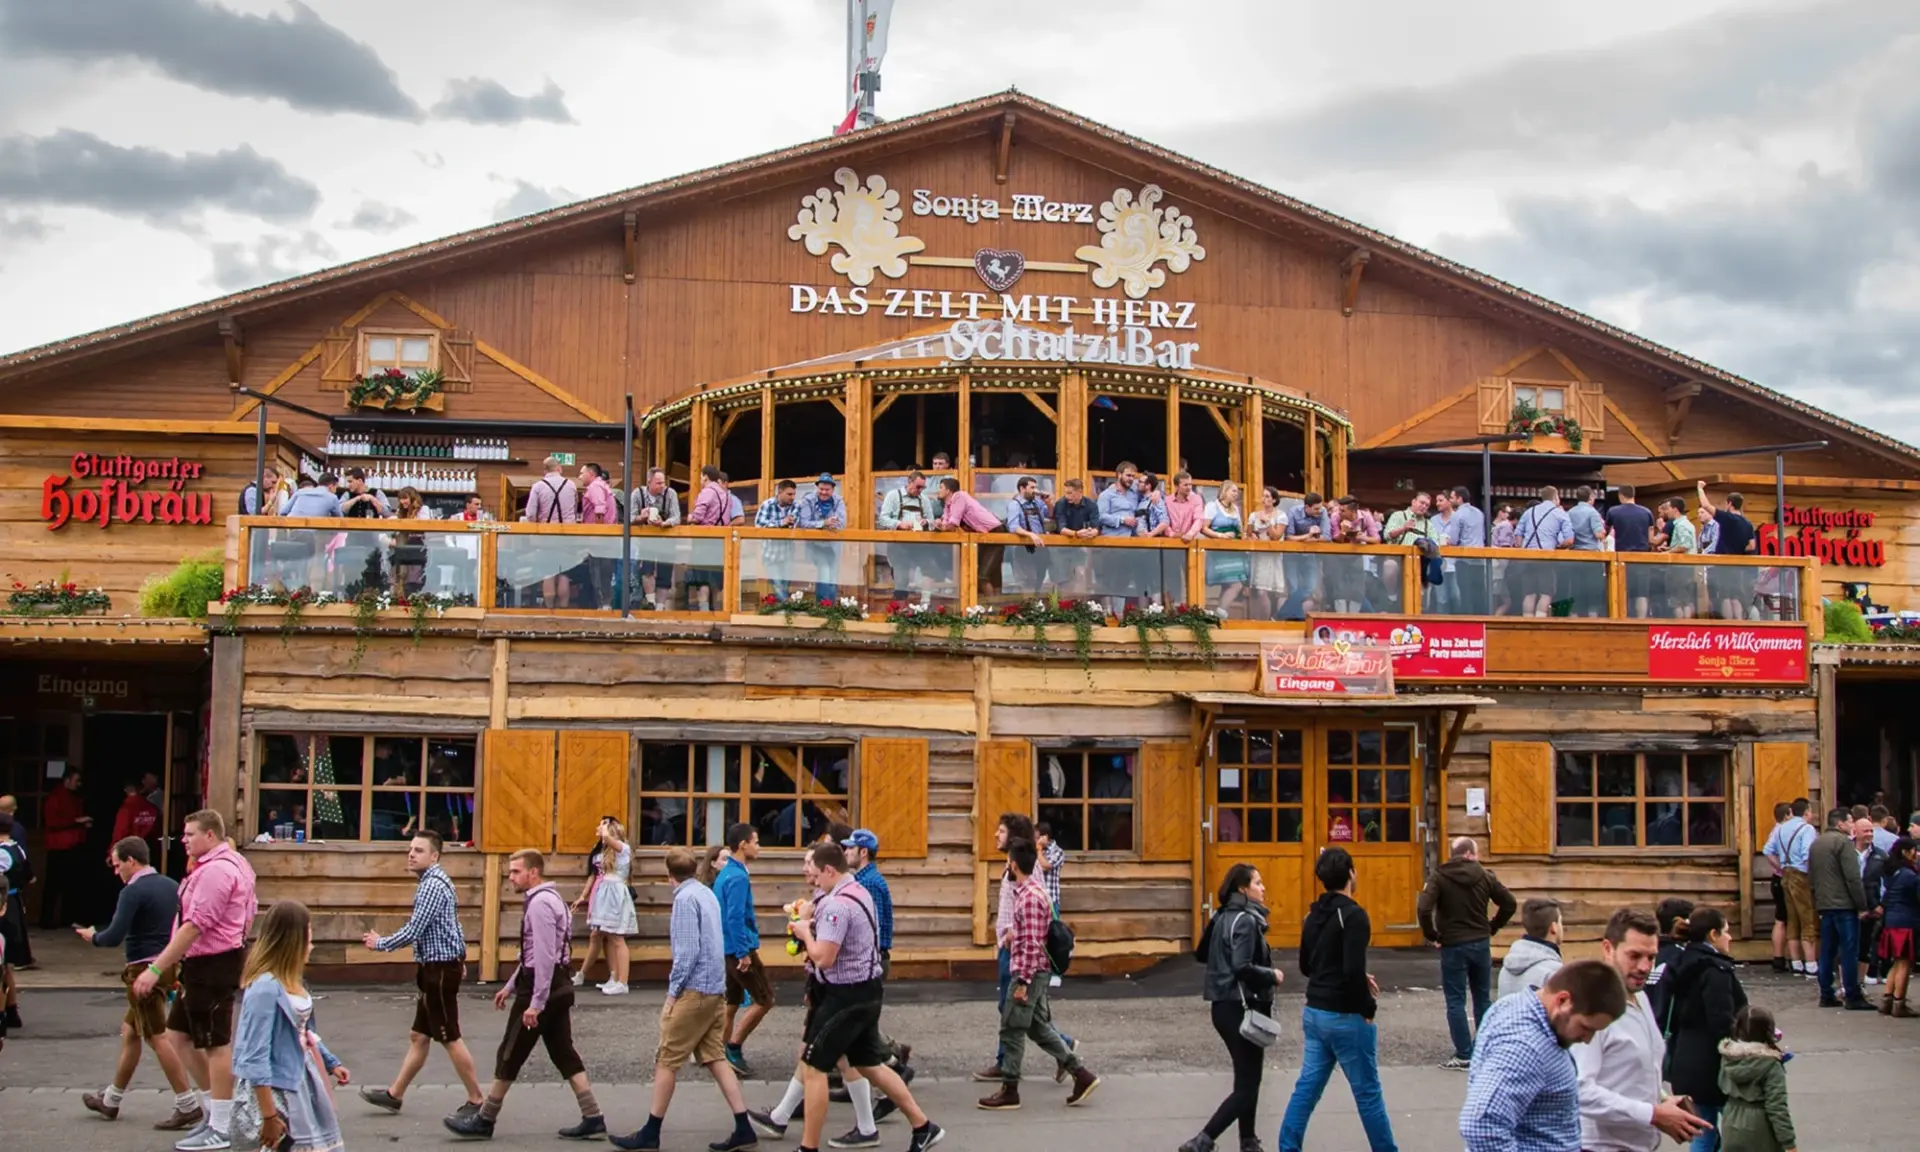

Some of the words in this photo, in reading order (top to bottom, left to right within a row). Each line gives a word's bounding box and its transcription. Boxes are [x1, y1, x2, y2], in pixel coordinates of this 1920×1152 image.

[912, 189, 999, 224] Sonja
[1012, 194, 1094, 223] Merz
[789, 285, 869, 315] DAS
[884, 289, 986, 319] ZELT
[999, 294, 1078, 323] MIT
[1092, 298, 1197, 328] HERZ
[71, 452, 202, 484] Stuttgarter
[41, 473, 212, 531] Hofbräu
[1650, 631, 1711, 649] Herzlich
[1715, 632, 1802, 653] Willkommen
[1698, 655, 1726, 667] Sonja
[38, 674, 128, 698] Eingang
[1279, 677, 1335, 691] Eingang
